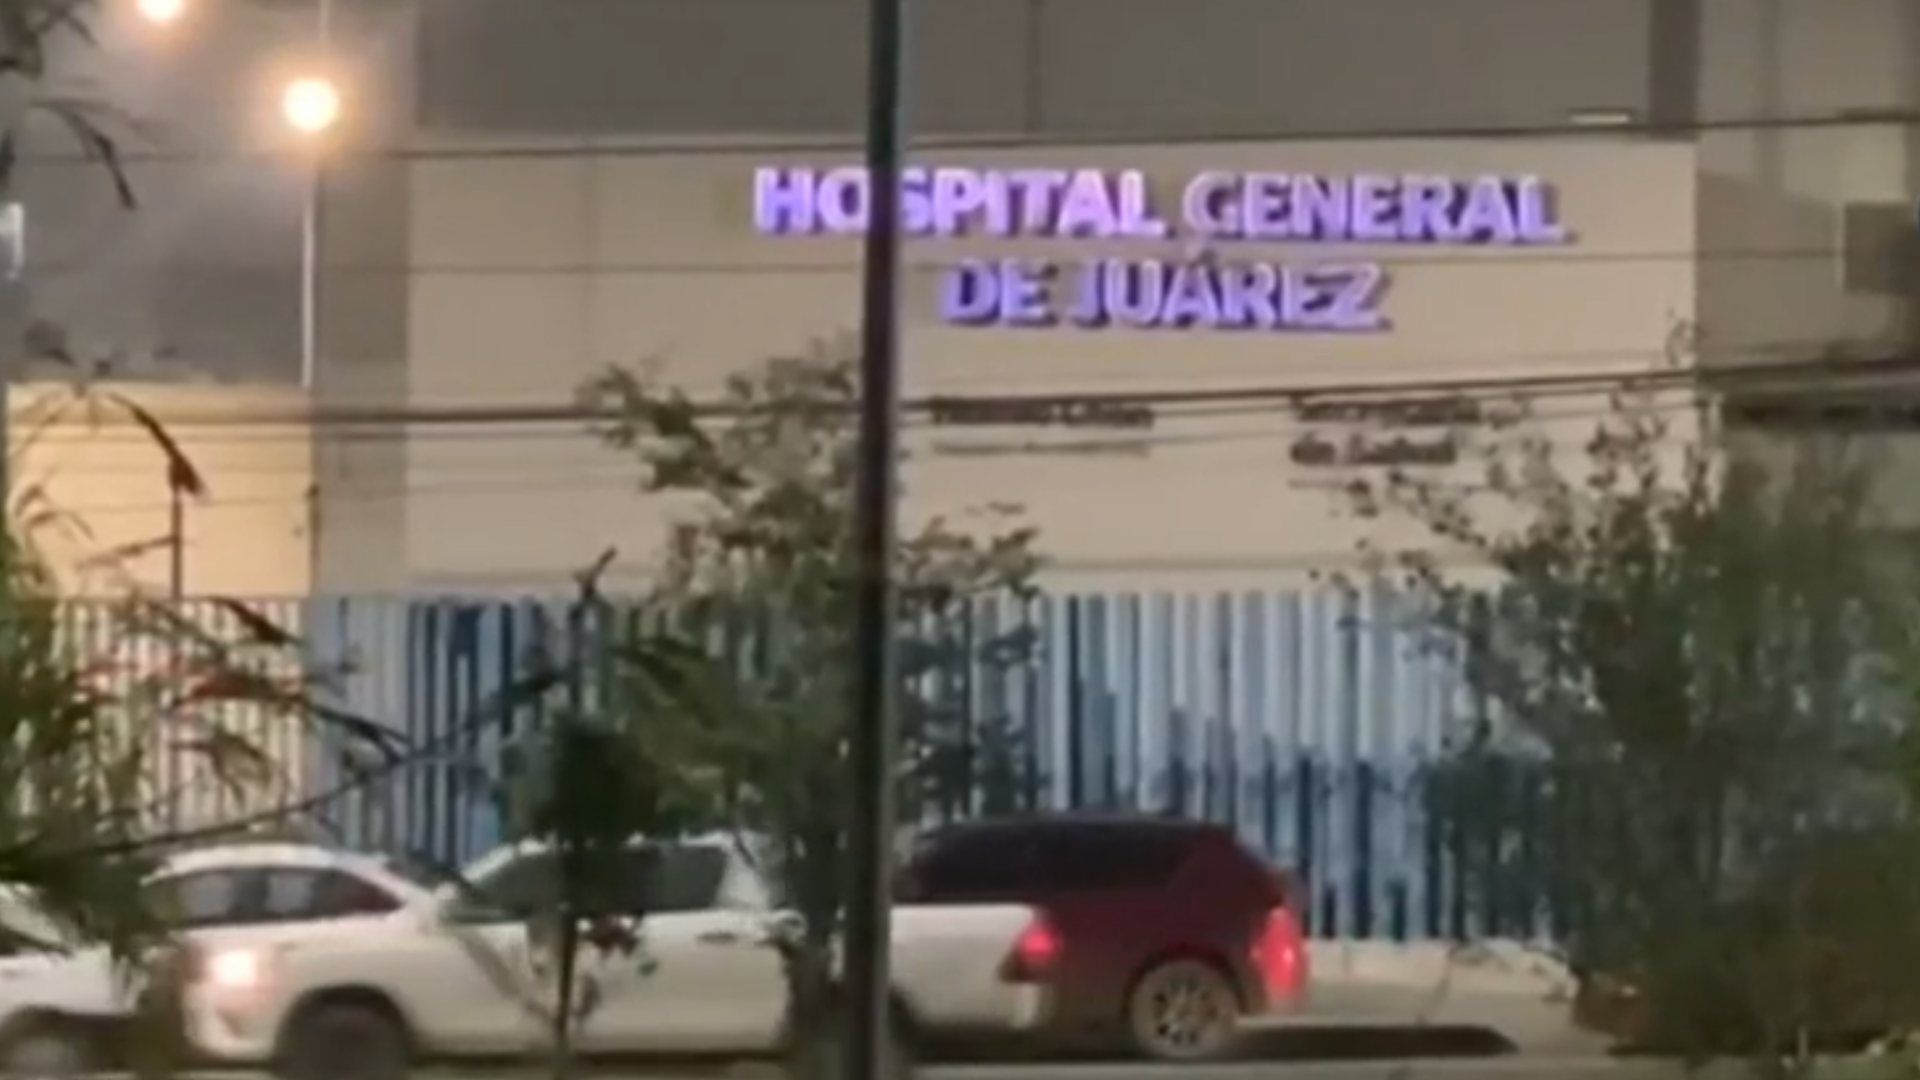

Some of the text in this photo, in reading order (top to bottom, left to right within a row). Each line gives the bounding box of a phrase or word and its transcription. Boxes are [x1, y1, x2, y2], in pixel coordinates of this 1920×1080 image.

[754, 166, 1570, 244] HOSPITAL GENERAL
[940, 248, 1390, 330] DE JUÁREZ
